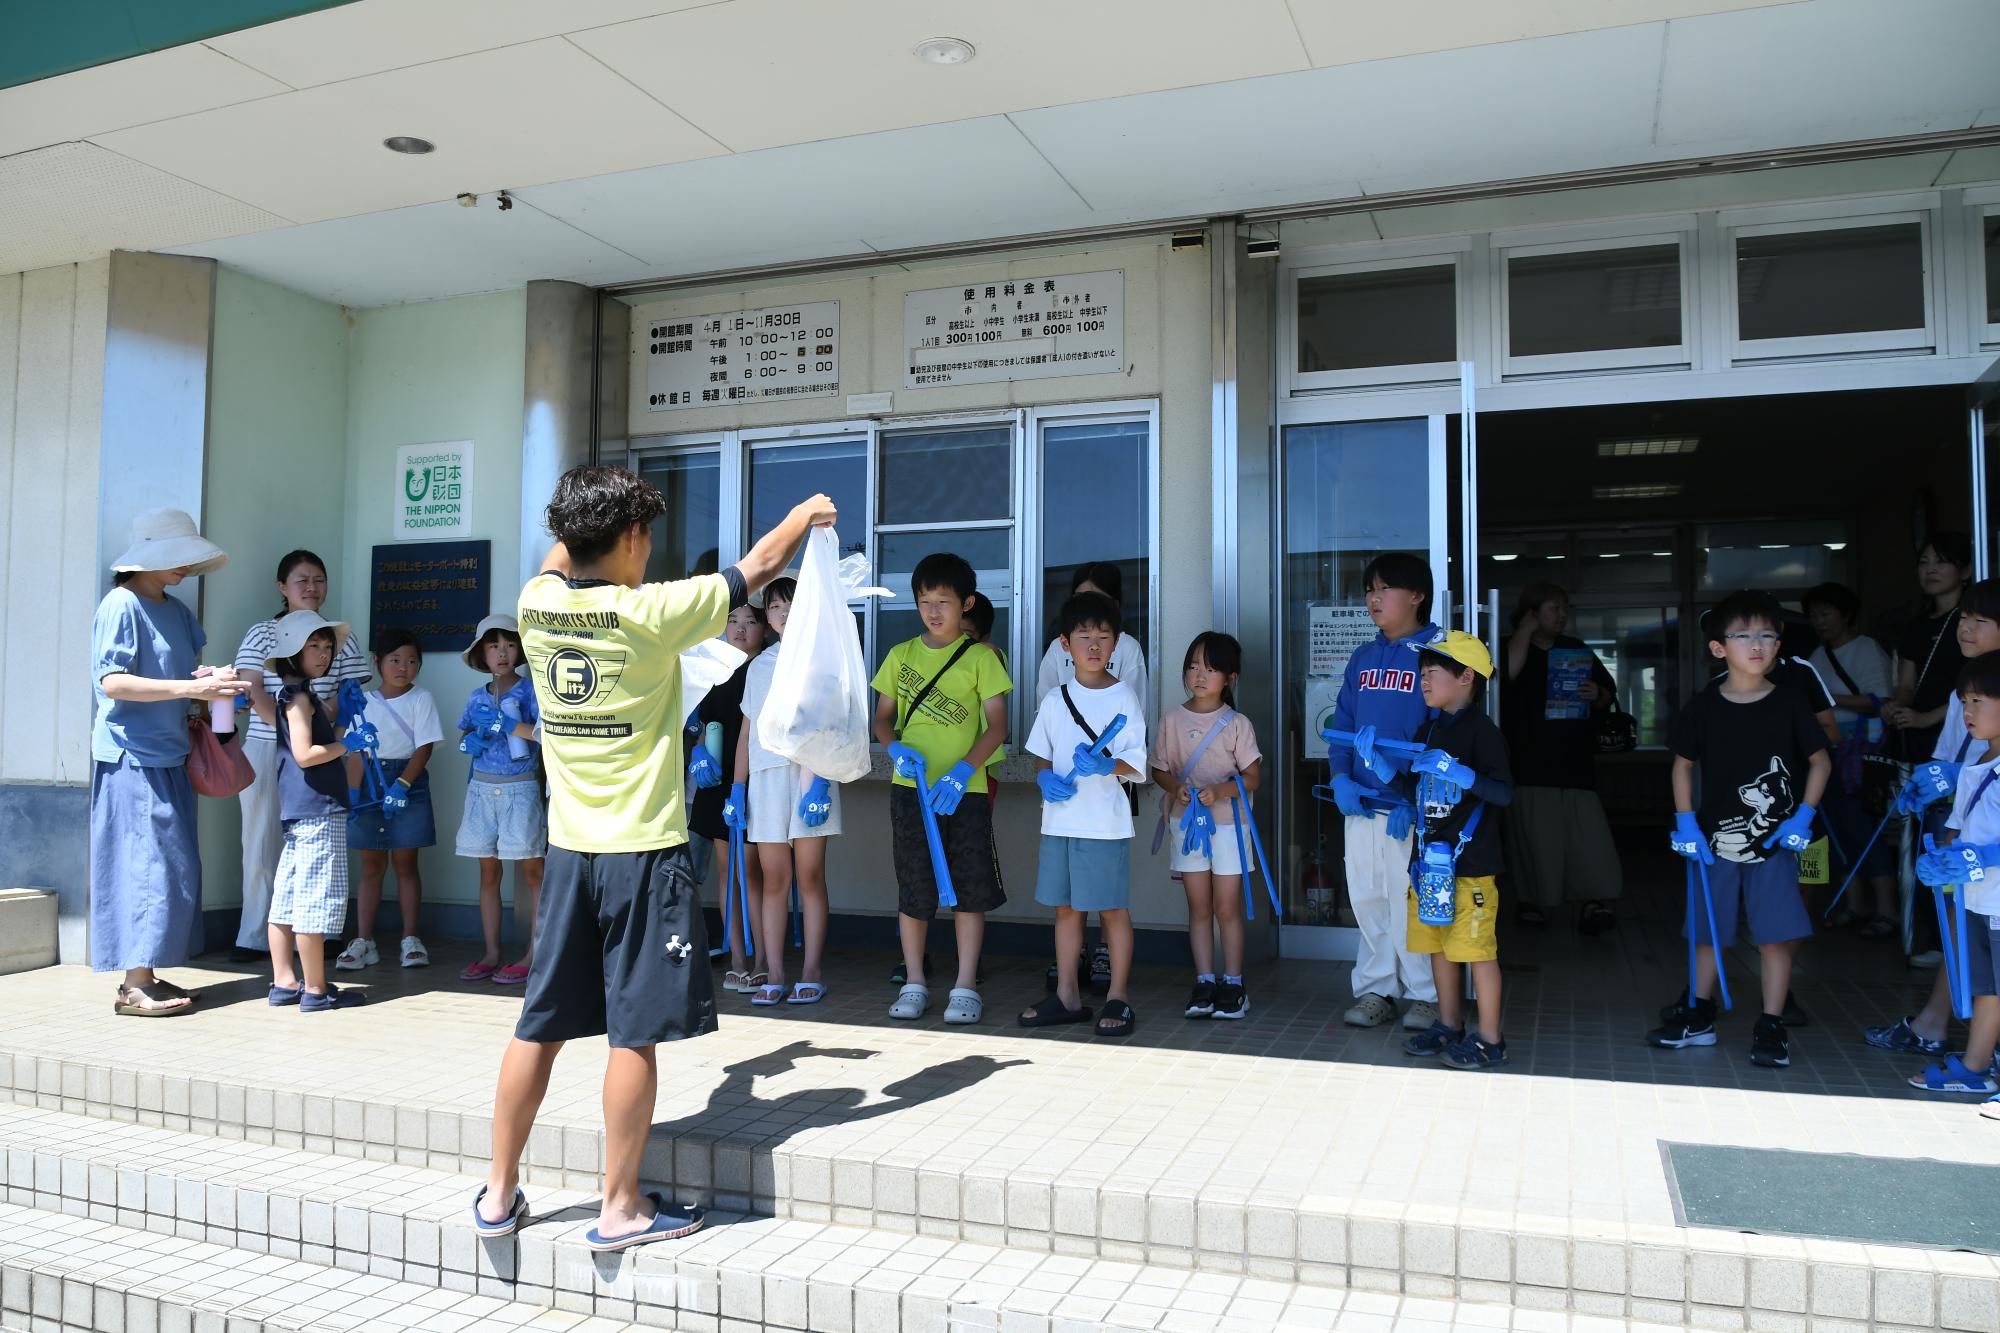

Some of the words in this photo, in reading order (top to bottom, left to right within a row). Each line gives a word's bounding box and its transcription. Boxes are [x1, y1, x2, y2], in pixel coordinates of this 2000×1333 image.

[964, 280, 1056, 301] 使用料金表
[709, 338, 727, 349] 午前
[709, 355, 728, 366] 午後
[709, 371, 728, 382] 夜間
[407, 453, 449, 465] Supported
[451, 453, 462, 462] by
[433, 465, 462, 482] 日本
[433, 483, 461, 500] 財団
[405, 505, 421, 516] THE
[424, 503, 460, 515] NIPPON
[404, 516, 460, 528] FOUNDATION
[542, 611, 587, 628] SPORTS
[586, 611, 620, 629] CLUB
[1359, 668, 1416, 693] PUMA
[577, 727, 591, 735] CAN
[591, 727, 610, 736] COME
[610, 726, 629, 735] TRUE
[1928, 765, 1949, 792] B&G
[1802, 859, 1819, 870] THE
[1963, 848, 1985, 882] B&G
